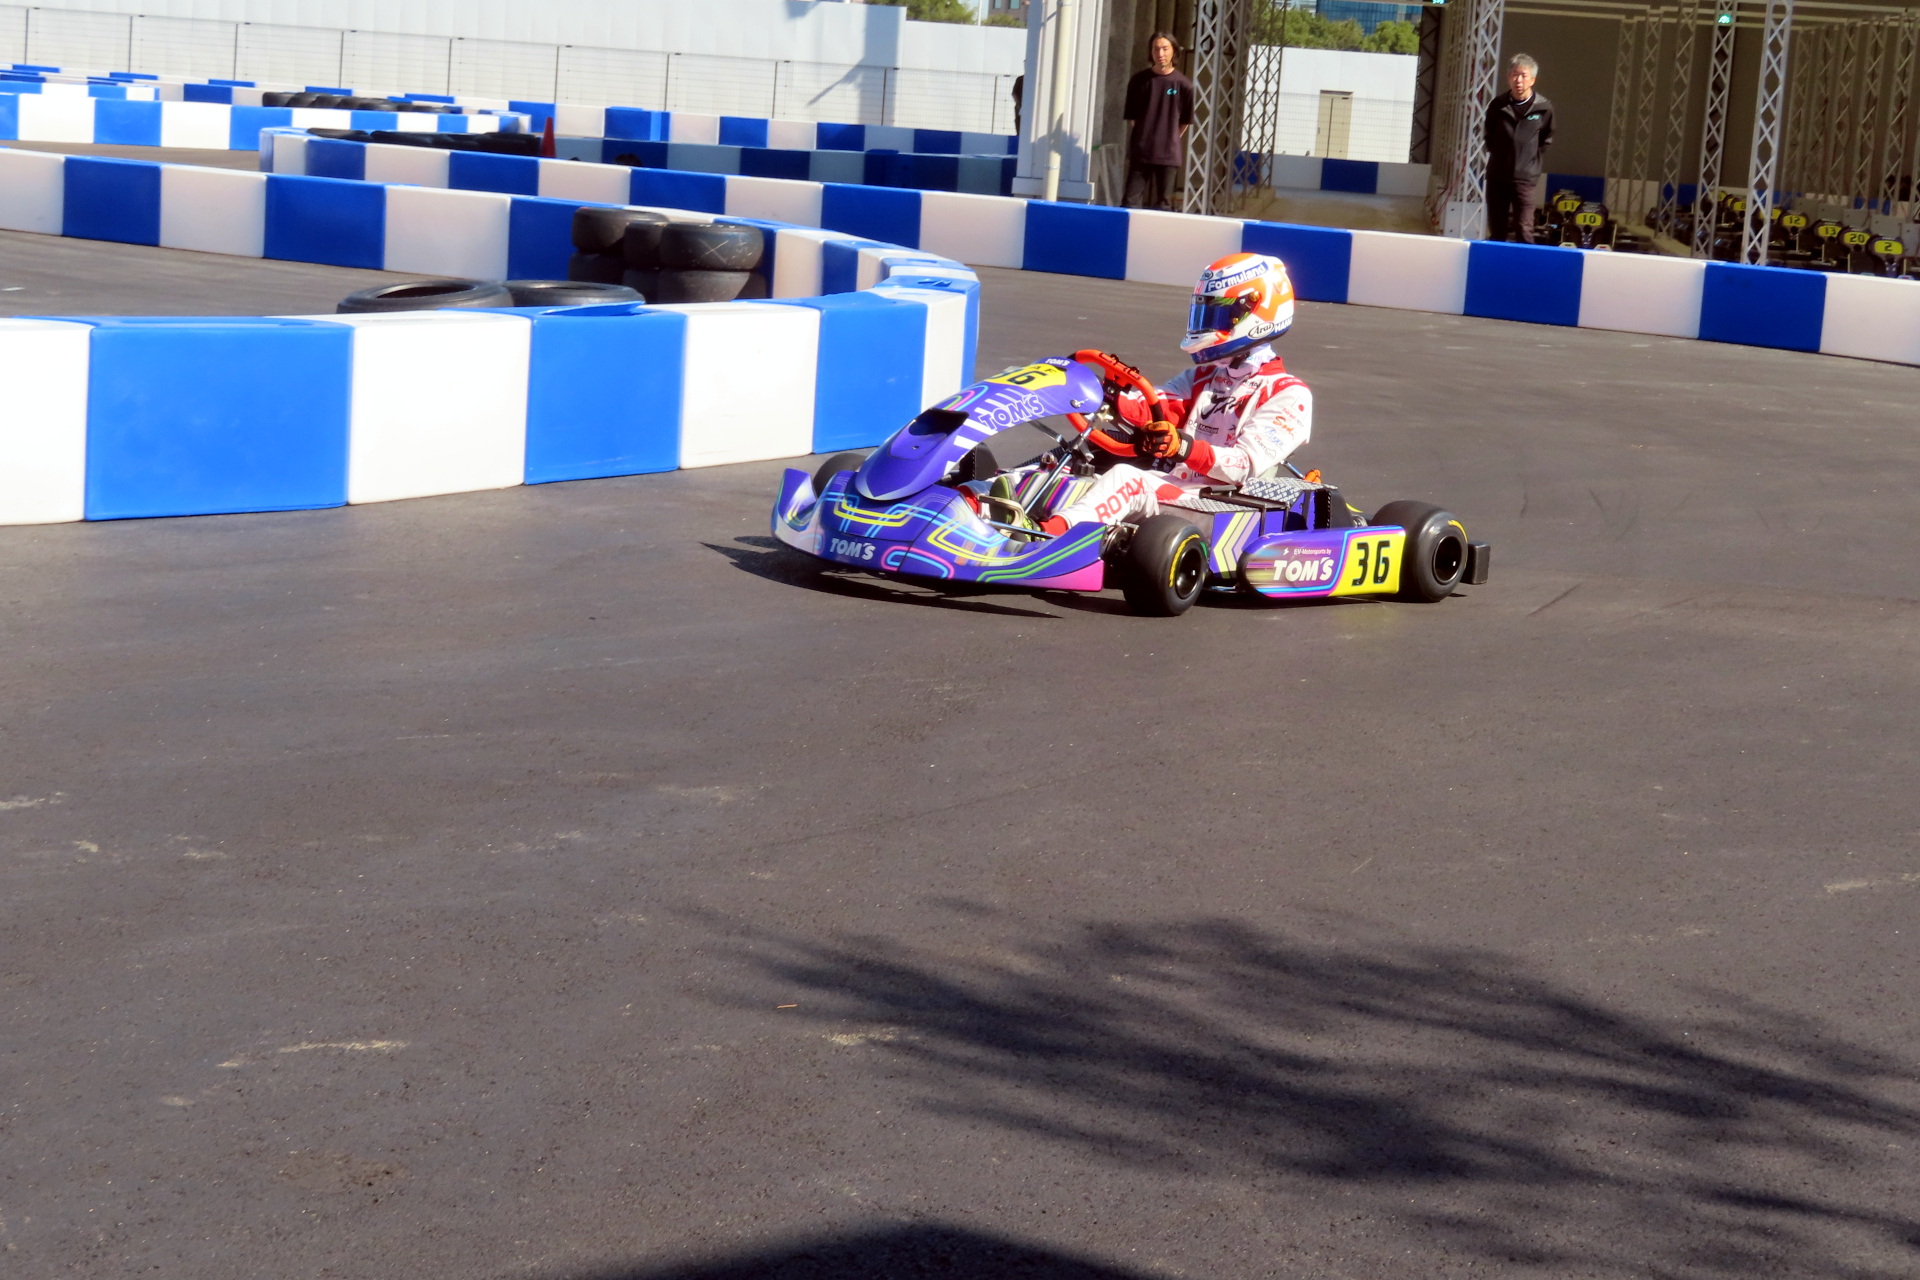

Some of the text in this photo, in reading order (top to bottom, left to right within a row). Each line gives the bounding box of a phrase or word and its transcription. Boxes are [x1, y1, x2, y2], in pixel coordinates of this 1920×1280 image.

[1564, 201, 1574, 210] 11
[1583, 214, 1597, 224] 10
[1790, 216, 1800, 224] 12
[1825, 226, 1836, 236] 13
[1850, 233, 1865, 243] 20
[1884, 241, 1892, 252] 2
[1208, 264, 1266, 292] Formuland
[1252, 323, 1273, 336] Arai
[1045, 358, 1071, 367] TOM'S
[978, 393, 1045, 430] TOM'S
[1094, 477, 1146, 523] ROTAX
[829, 537, 876, 560] TOM'S
[1273, 556, 1334, 582] TOM'S
[1352, 540, 1390, 586] 36
